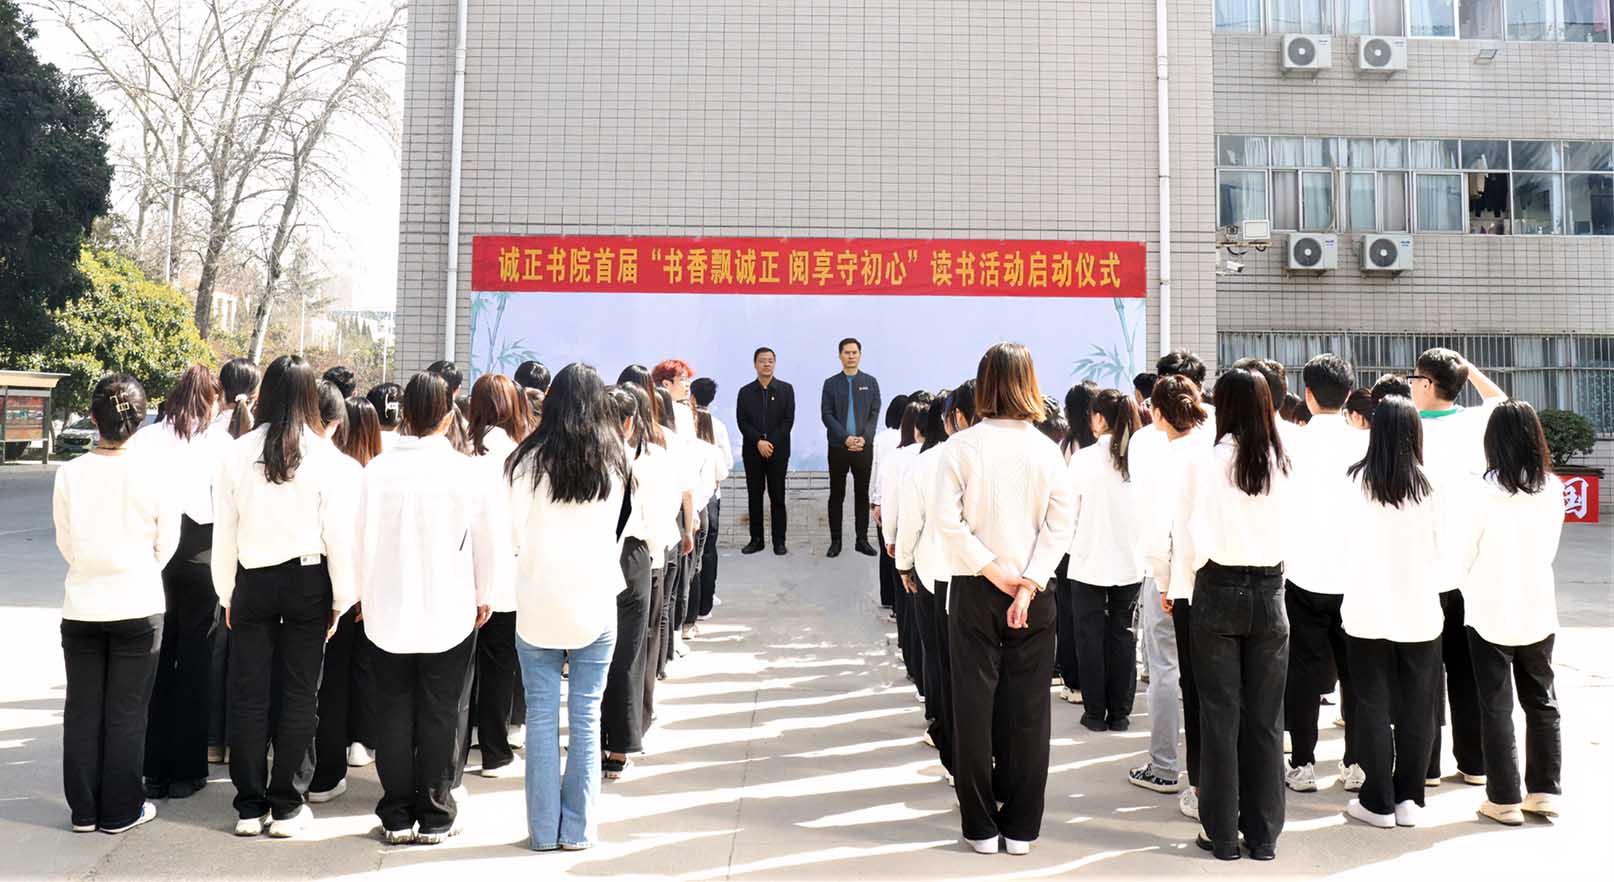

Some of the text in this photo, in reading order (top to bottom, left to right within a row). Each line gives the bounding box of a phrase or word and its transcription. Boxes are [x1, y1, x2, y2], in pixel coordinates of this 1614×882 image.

[788, 248, 1121, 288] 阅享守初心”读书活动启动仪式
